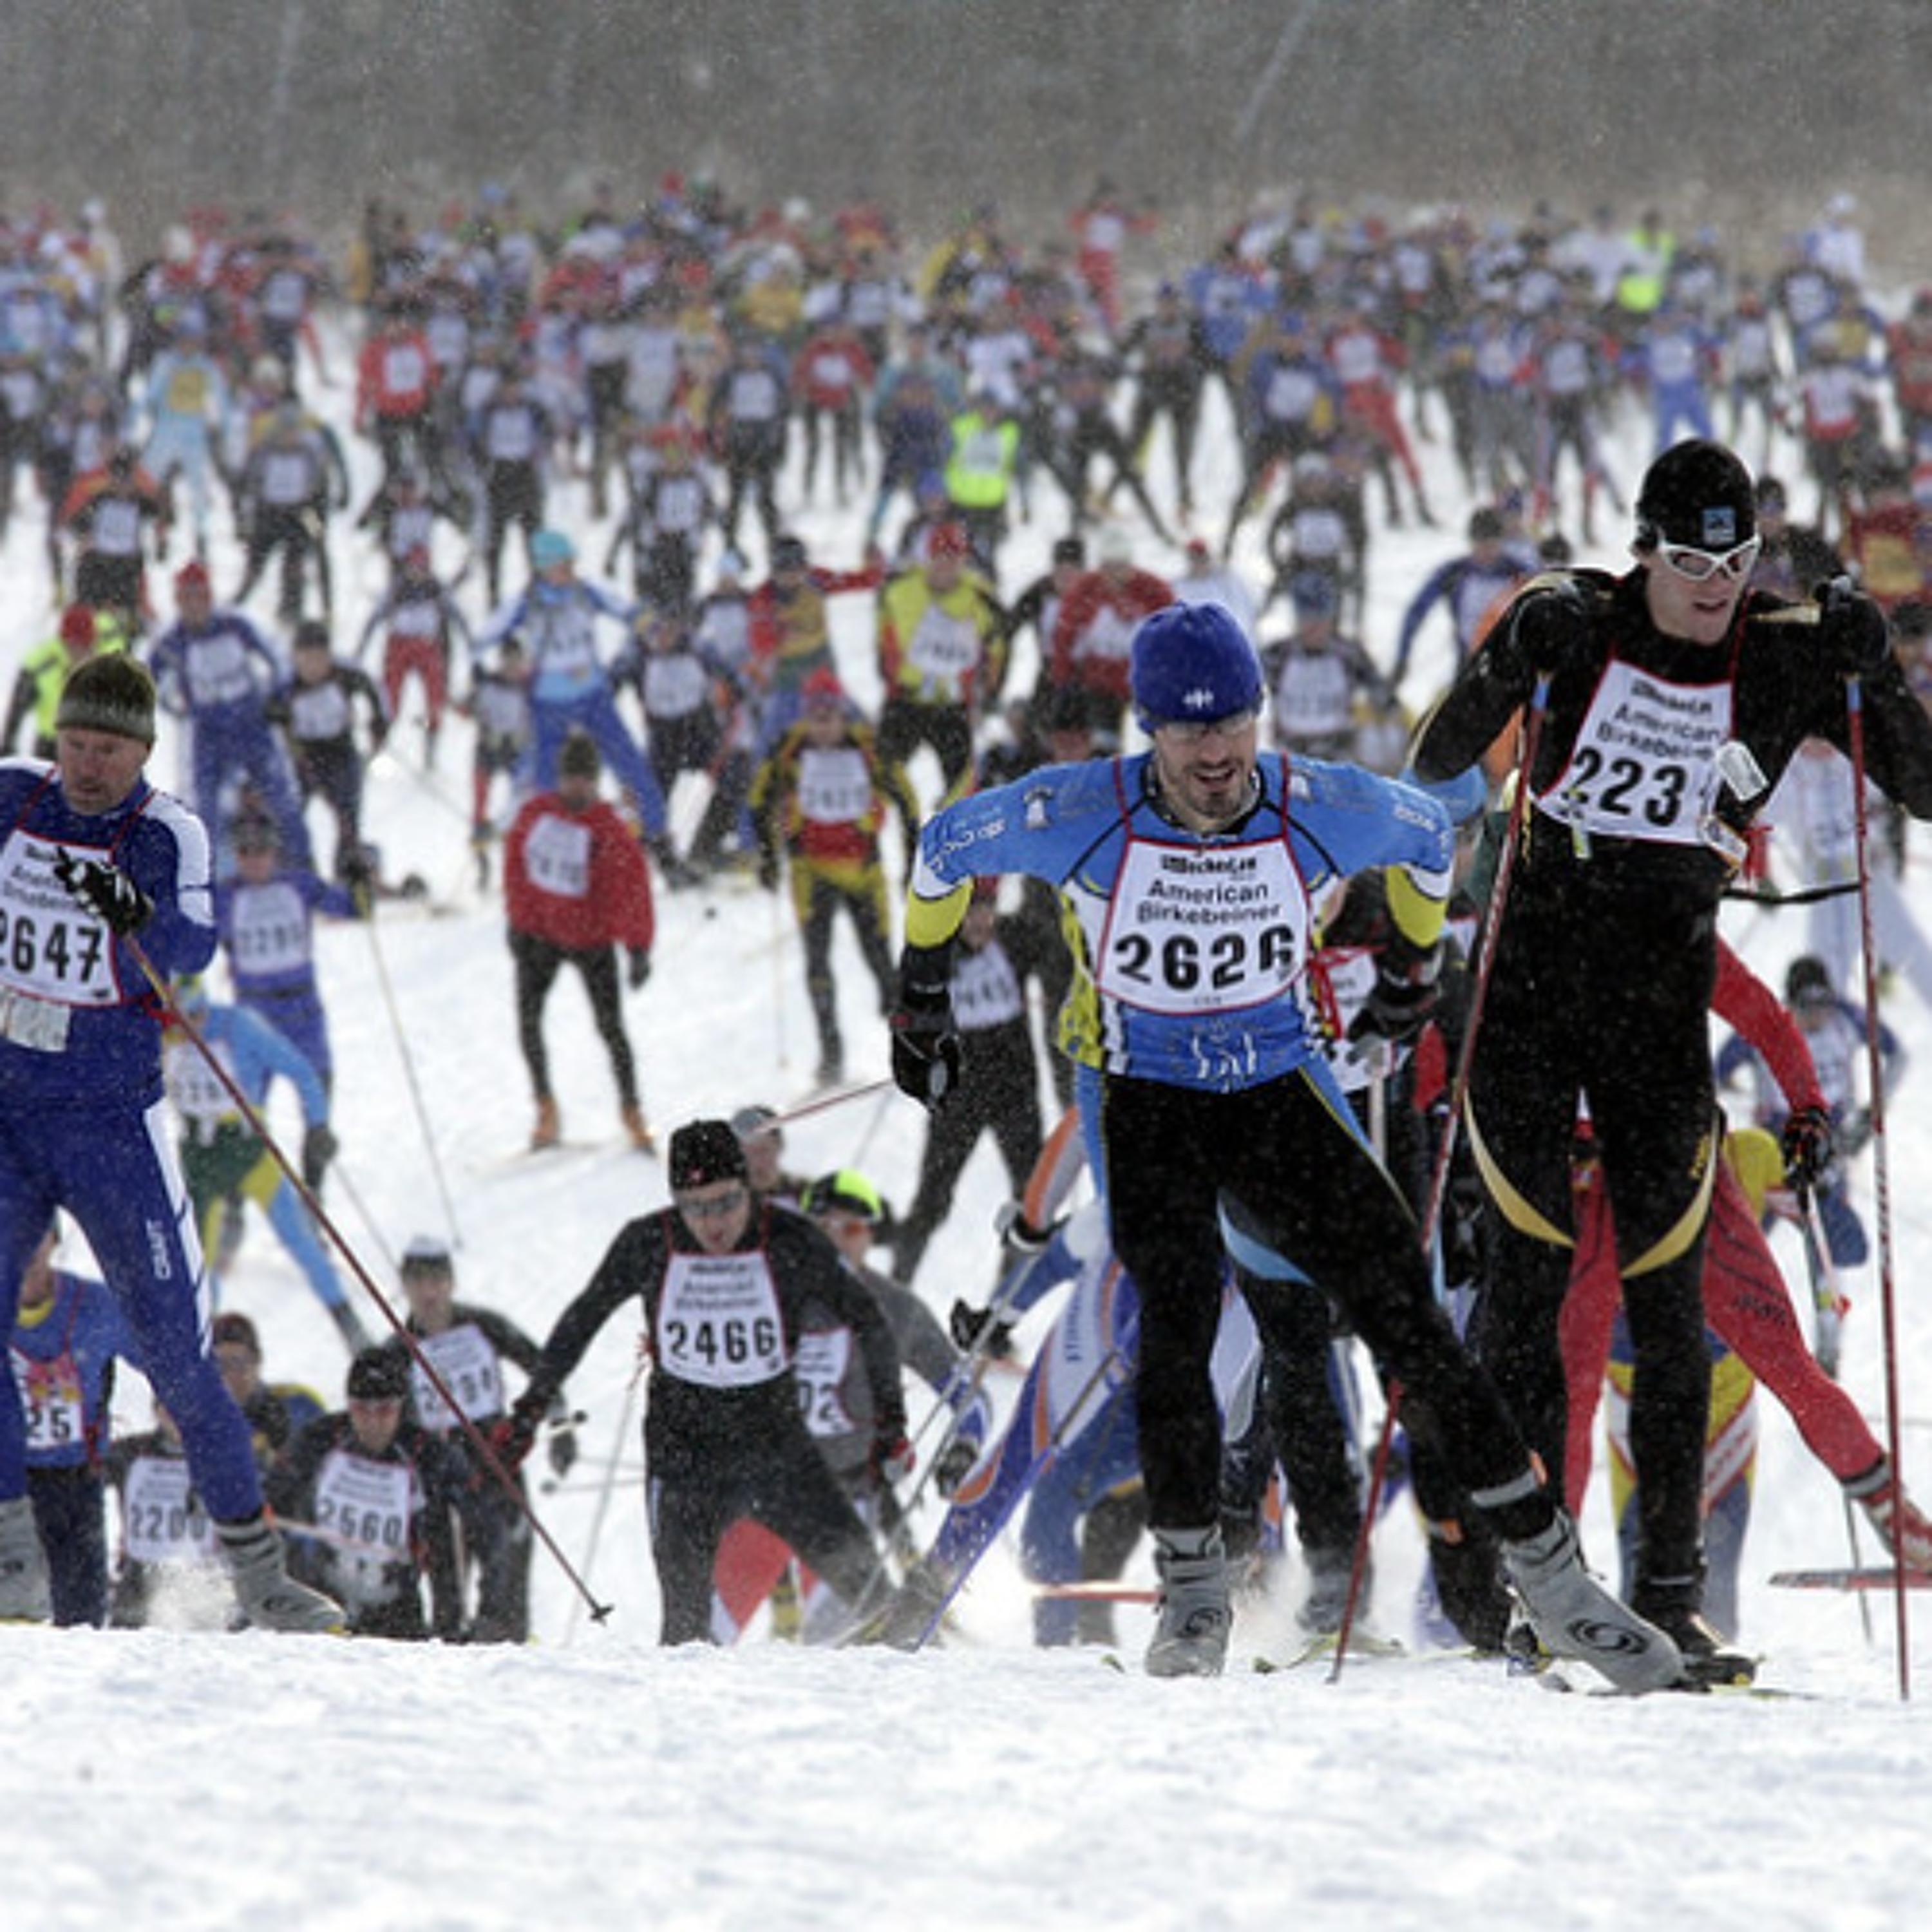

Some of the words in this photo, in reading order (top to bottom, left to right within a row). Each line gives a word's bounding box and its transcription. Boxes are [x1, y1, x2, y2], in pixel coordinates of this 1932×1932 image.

[1560, 746, 1714, 827] 223
[1137, 900, 1281, 924] Birkebeiner
[1147, 879, 1269, 905] American
[1115, 924, 1295, 990] 2626
[665, 1318, 777, 1366] 2466
[317, 1497, 403, 1548] 2560
